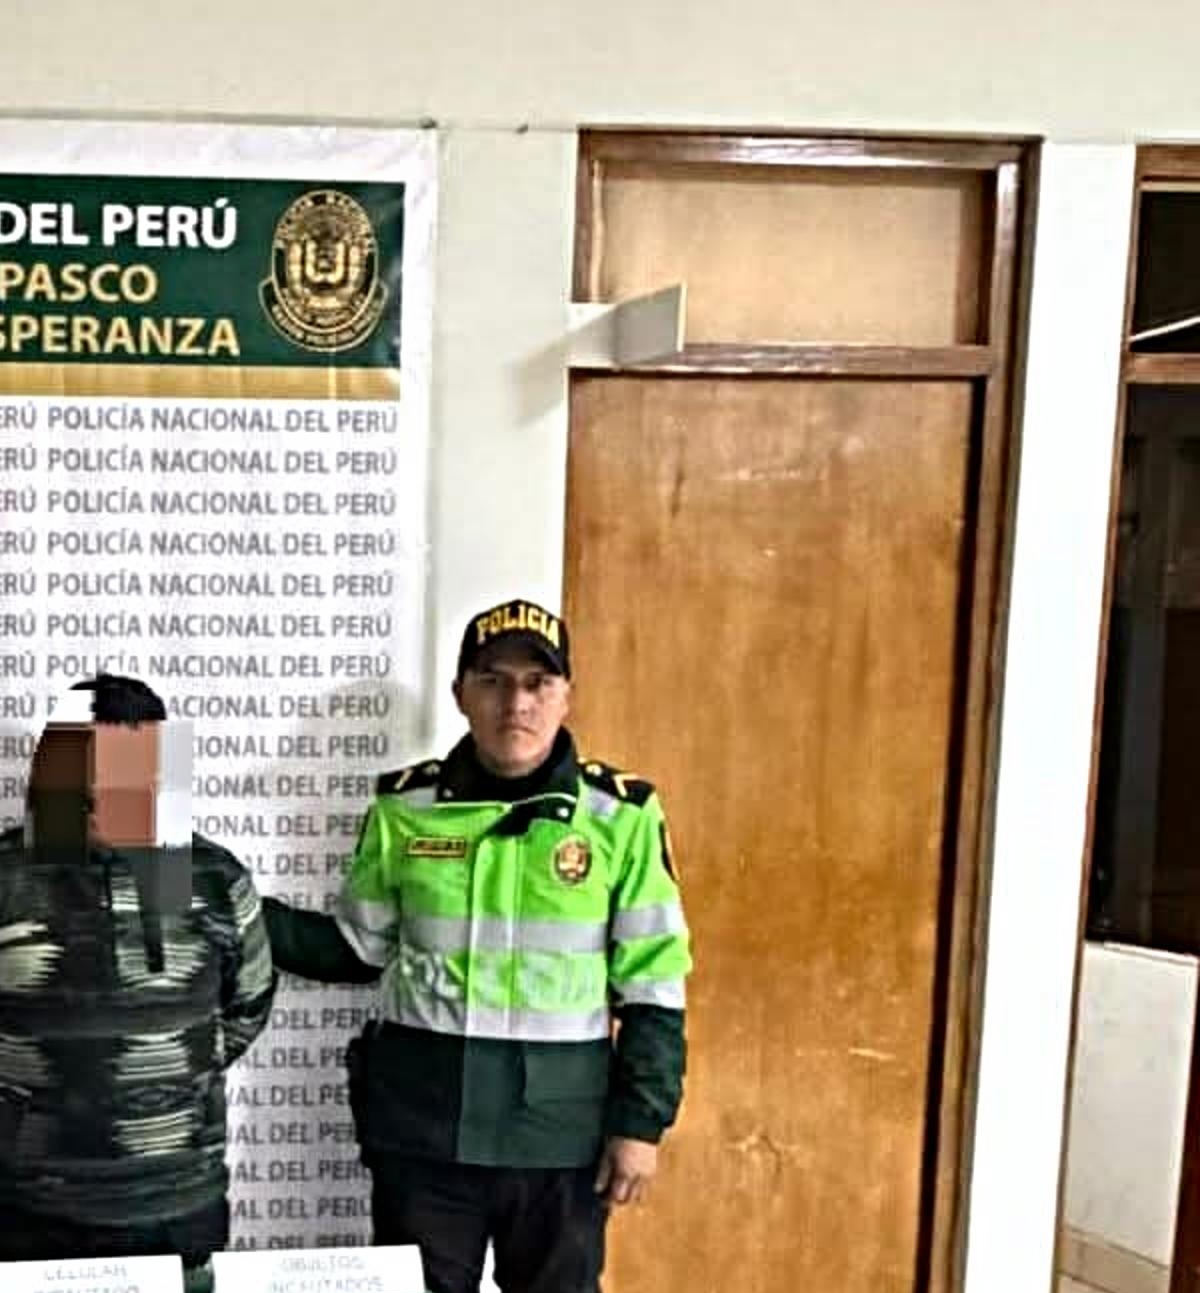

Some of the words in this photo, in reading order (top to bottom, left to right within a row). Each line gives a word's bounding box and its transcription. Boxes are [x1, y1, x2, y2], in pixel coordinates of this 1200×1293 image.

[102, 198, 238, 249] PERÚ
[47, 400, 145, 430] POLICÍA
[151, 408, 279, 432] NACIONAL
[284, 410, 330, 432] DEL
[337, 405, 397, 433] PERÚ
[47, 442, 144, 472] POLICÍA
[151, 449, 278, 473] NACIONAL
[284, 451, 329, 474] DEL
[336, 447, 396, 474] PERÚ
[47, 484, 144, 514] POLICÍA
[150, 491, 278, 514] NACIONAL
[284, 492, 329, 515] DEL
[335, 488, 396, 515] PERÚ
[47, 525, 143, 555] POLICÍA
[150, 532, 277, 555] NACIONAL
[282, 533, 328, 556] DEL
[334, 529, 395, 556] PERÚ
[47, 567, 142, 596] POLICÍA
[150, 573, 275, 596] NACIONAL
[281, 574, 326, 596] DEL
[332, 569, 393, 597] PERÚ
[47, 608, 141, 637] POLICÍA
[149, 614, 275, 637] NACIONAL
[281, 615, 325, 637] DEL
[331, 610, 392, 637] PERÚ
[476, 604, 560, 648] POLICIA
[149, 655, 274, 677] NACIONAL
[280, 655, 324, 677] DEL
[331, 650, 391, 677] PERÚ
[168, 695, 273, 718] ACIONAL
[279, 695, 324, 717] DEL
[329, 690, 391, 717] PERÚ
[278, 735, 323, 757] DEL
[328, 730, 389, 757] PERÚ
[276, 775, 321, 797] DEL
[327, 775, 369, 797] PER
[276, 815, 320, 837] DEL
[275, 854, 319, 876] DEL
